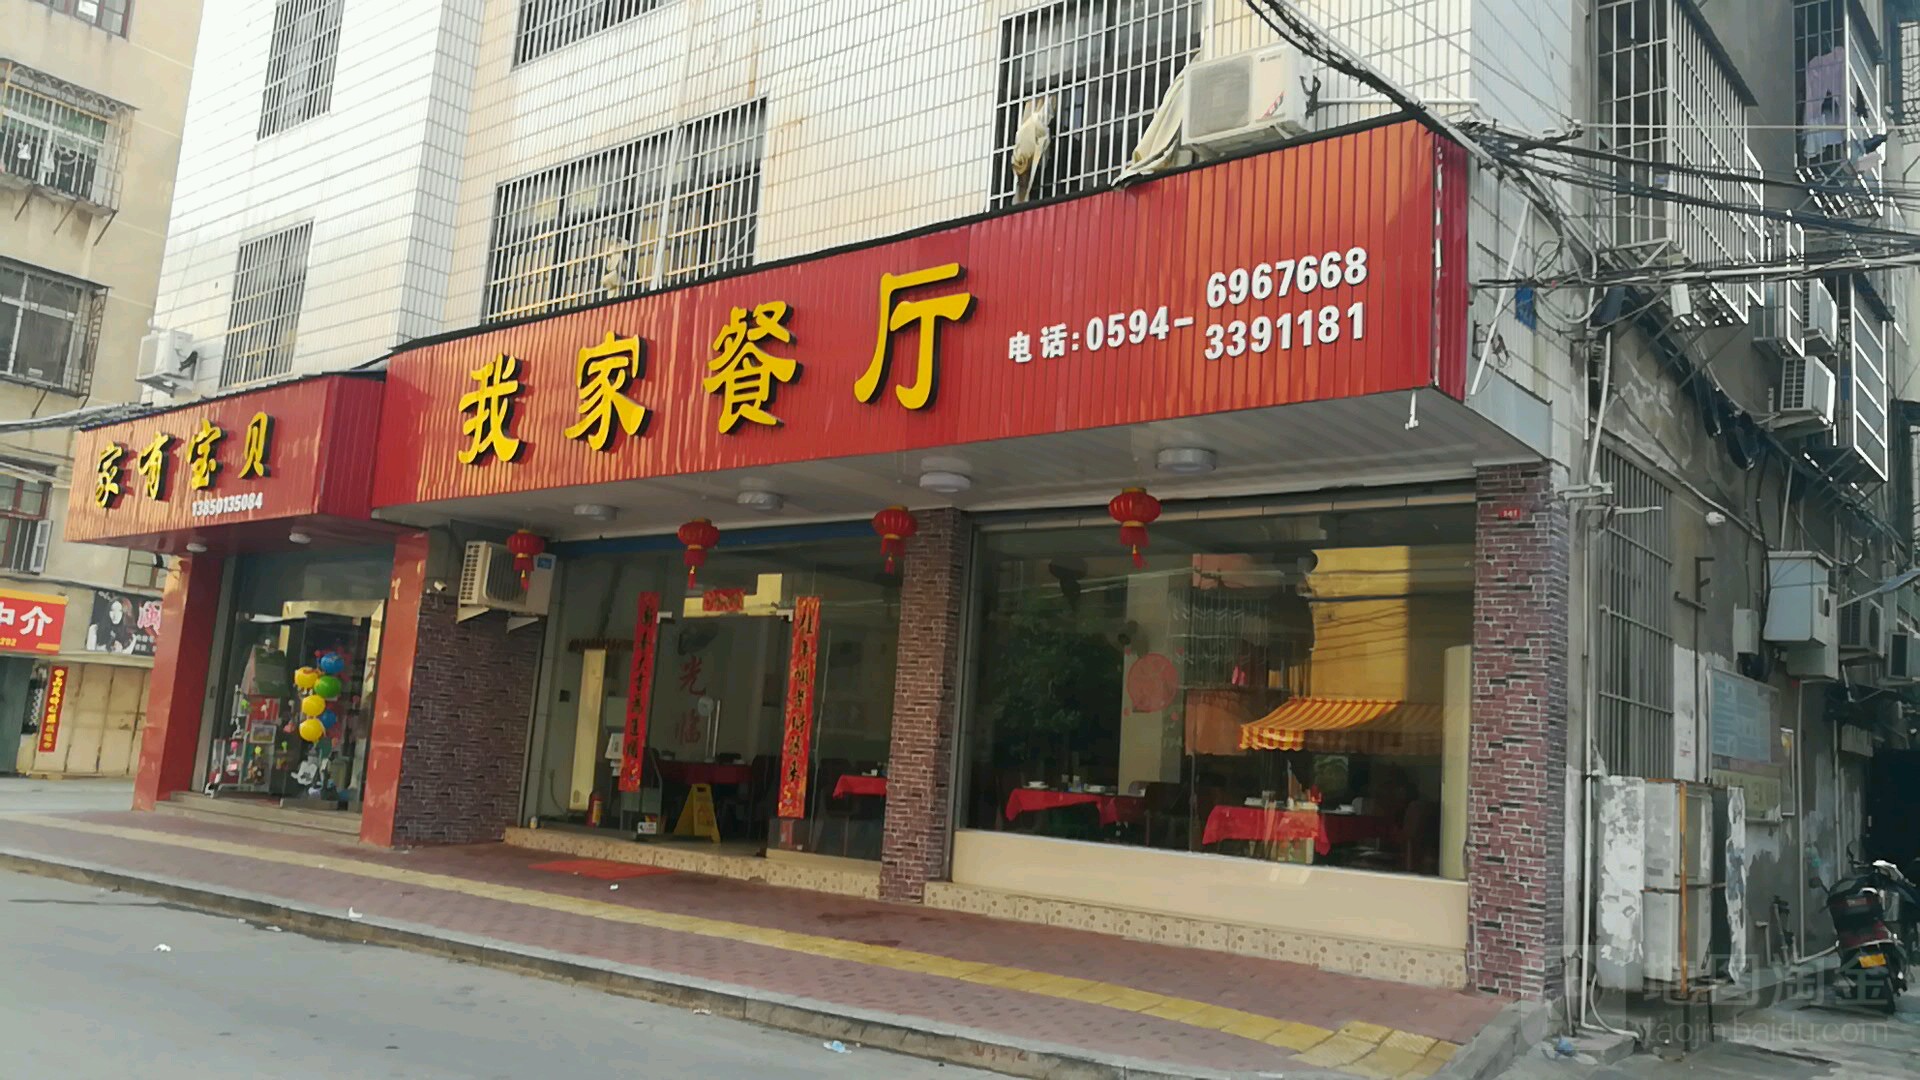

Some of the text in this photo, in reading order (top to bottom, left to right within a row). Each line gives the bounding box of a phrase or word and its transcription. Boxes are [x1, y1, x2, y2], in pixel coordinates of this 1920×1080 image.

[1206, 246, 1368, 308] 6967668
[1204, 301, 1366, 360] 3391181
[458, 262, 974, 465] 我家餐厅
[95, 411, 273, 508] 家有宝贝
[191, 492, 264, 517] 13850135084
